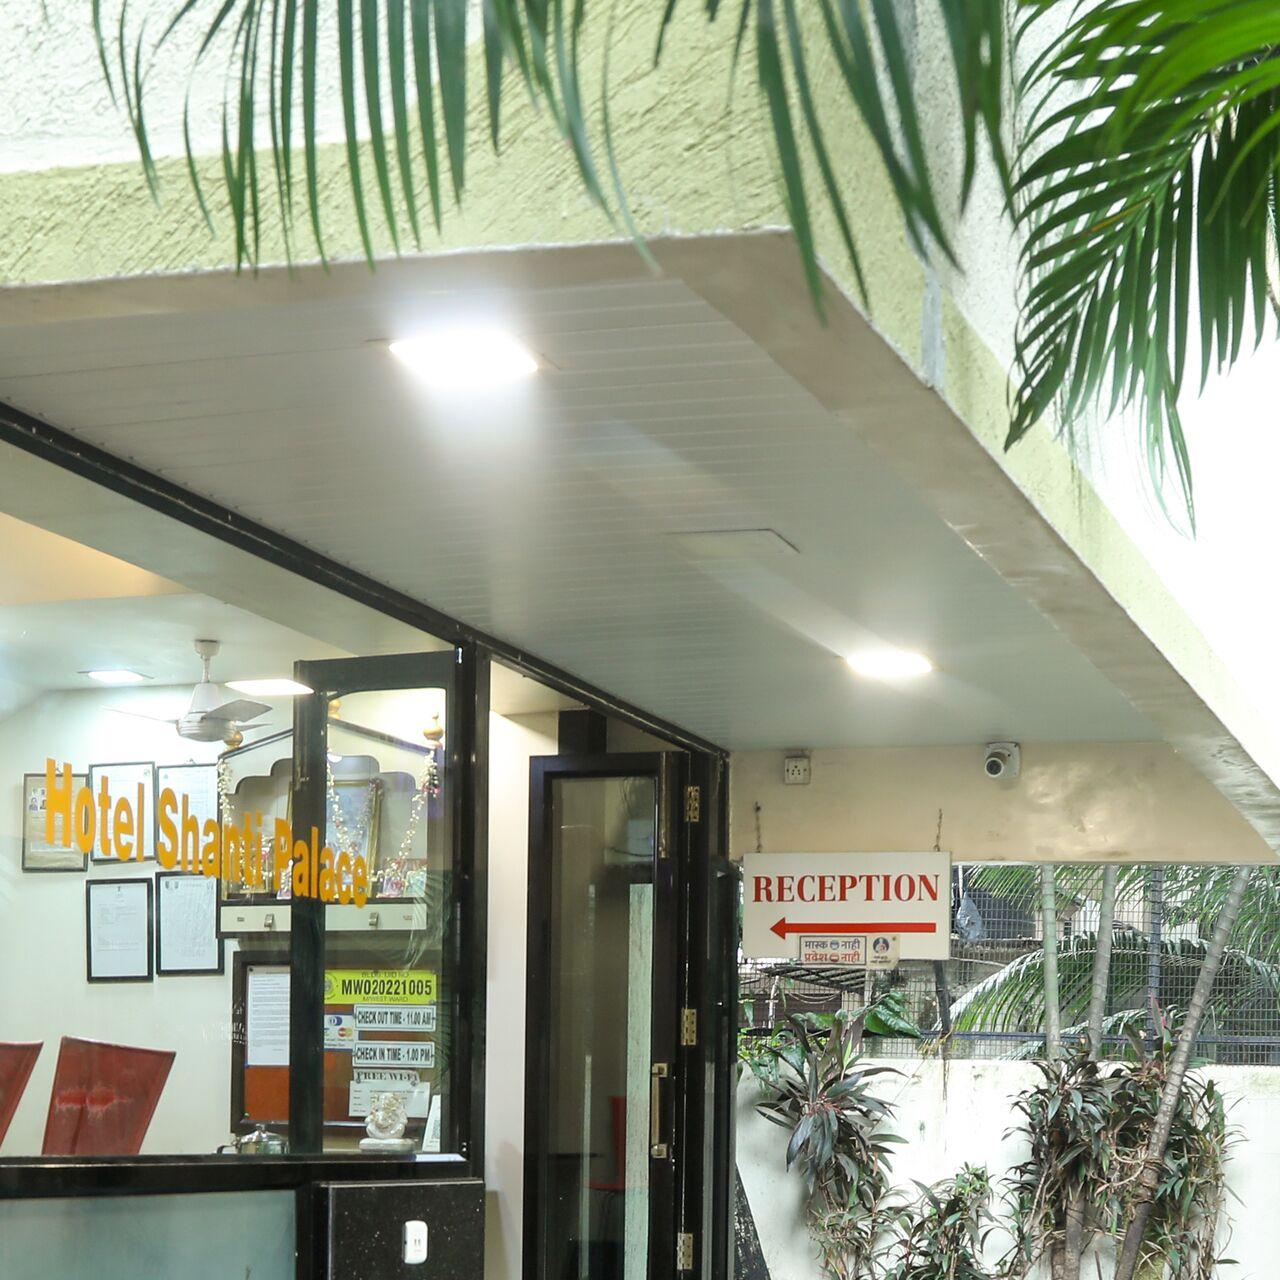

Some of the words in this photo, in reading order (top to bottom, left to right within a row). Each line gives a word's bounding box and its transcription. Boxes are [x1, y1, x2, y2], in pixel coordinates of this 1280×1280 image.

[45, 757, 144, 862] Hotel
[156, 787, 264, 889] Shanti
[273, 817, 369, 909] Palace
[752, 874, 940, 903] RECEPTION
[804, 940, 828, 950] मास्क
[841, 938, 861, 950] नाही
[804, 951, 828, 962] प्रवेश
[841, 951, 861, 962] नाही
[358, 1011, 376, 1025] CHECK
[377, 1011, 388, 1025] OUT
[390, 1011, 402, 1025] TIME
[421, 1011, 431, 1025] AM
[357, 1048, 377, 1060] CHECK
[379, 1048, 385, 1060] IN
[386, 1048, 401, 1060] TIME
[407, 1049, 419, 1061] 1.00
[420, 1049, 430, 1061] PM
[357, 1072, 386, 1080] FREE
